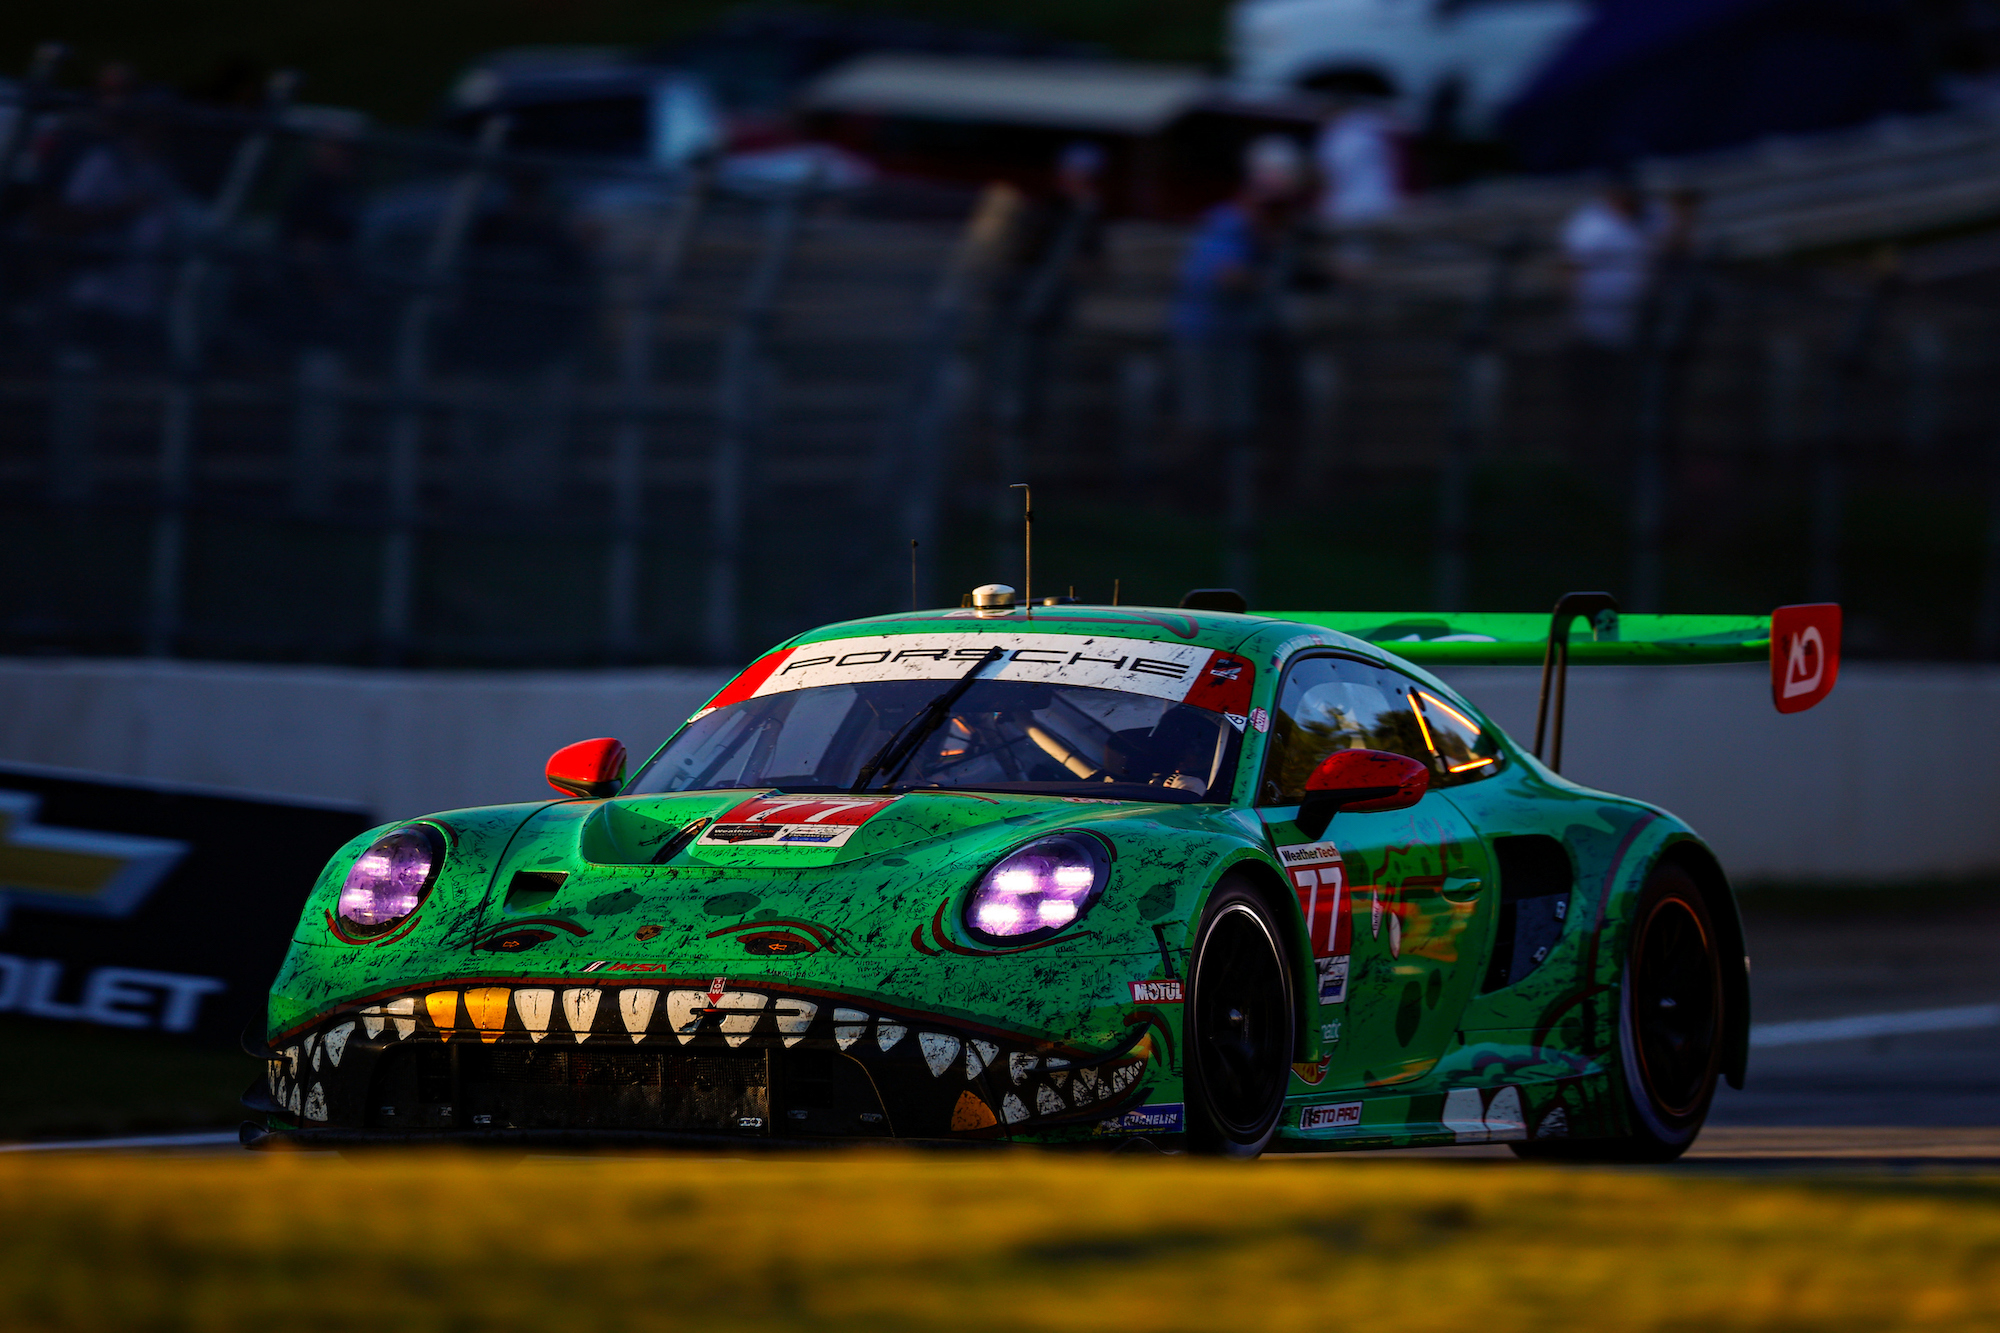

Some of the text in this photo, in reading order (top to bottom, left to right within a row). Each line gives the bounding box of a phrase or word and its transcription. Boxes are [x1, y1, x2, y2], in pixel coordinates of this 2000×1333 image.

[781, 648, 1190, 680] PORSCHE
[745, 800, 875, 823] 77
[1281, 846, 1341, 861] WeatherTech
[1294, 866, 1343, 952] 77
[607, 962, 667, 973] IMSA
[711, 979, 723, 994] TOW
[1134, 982, 1183, 1001] MOTUL
[1124, 1113, 1177, 1127] MICHELIN
[1337, 1106, 1360, 1122] PRO
